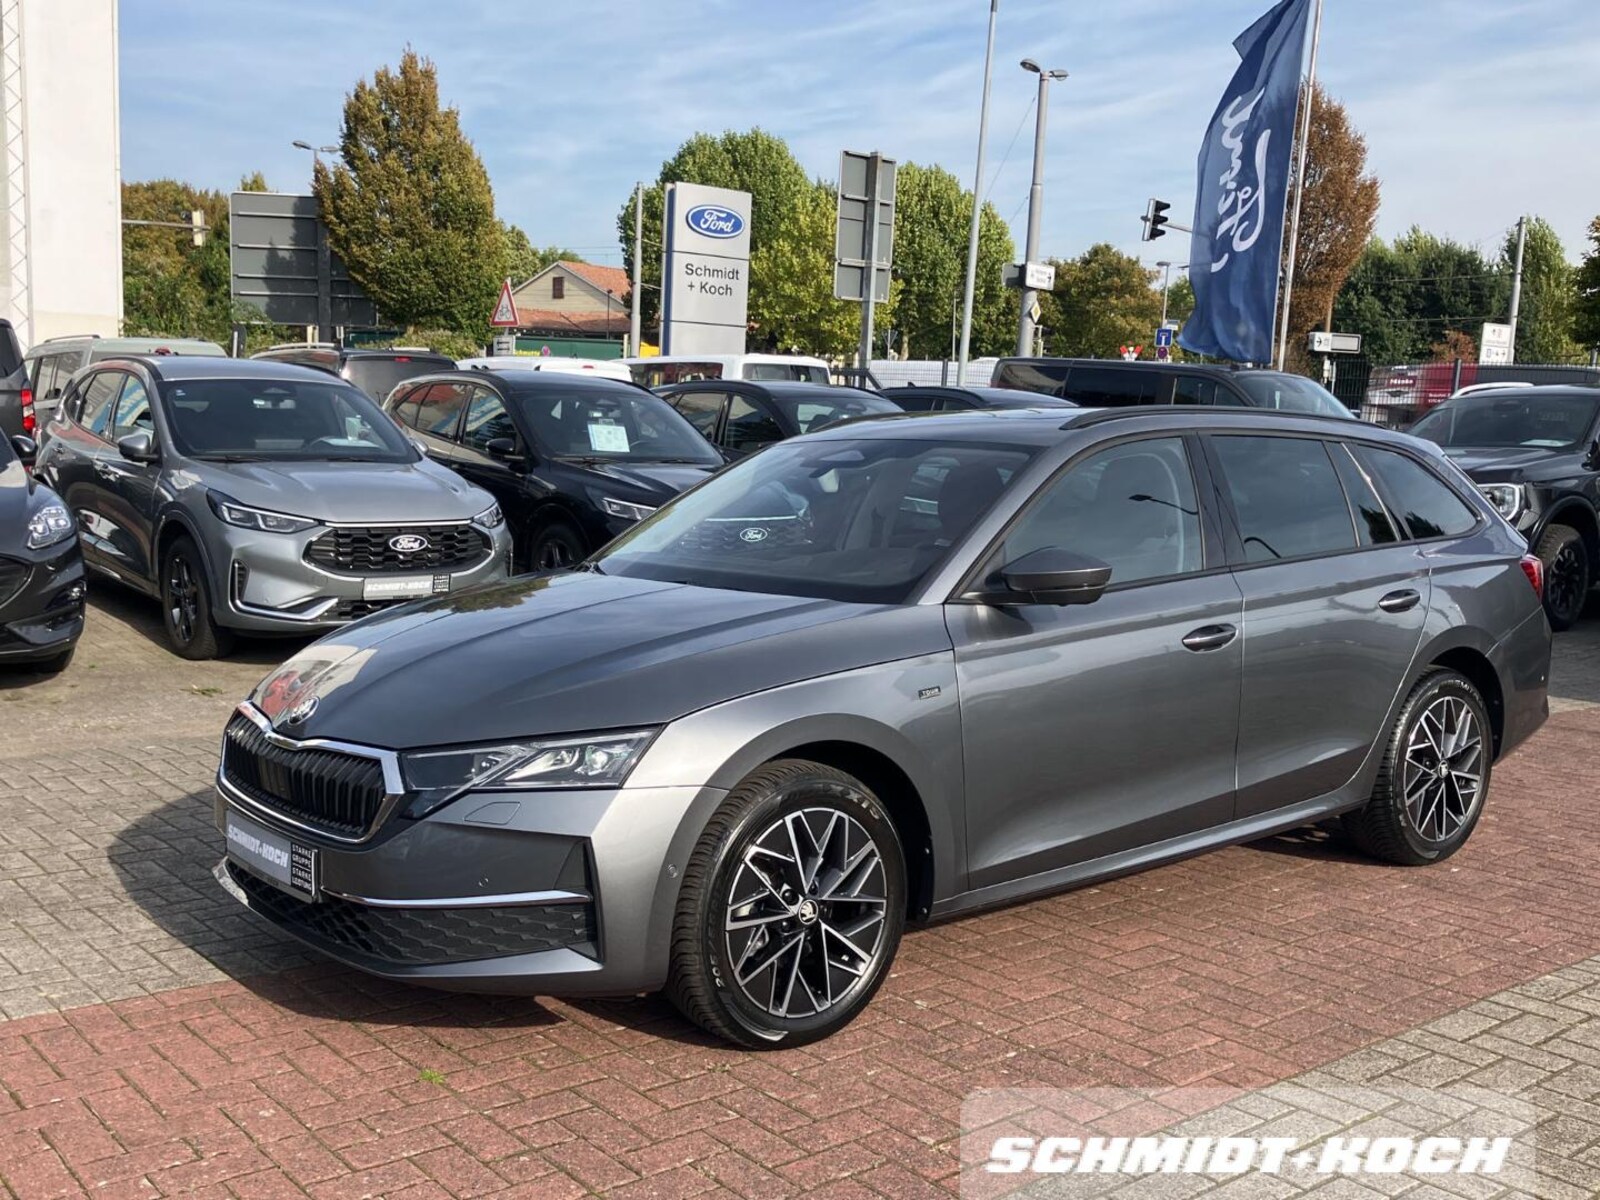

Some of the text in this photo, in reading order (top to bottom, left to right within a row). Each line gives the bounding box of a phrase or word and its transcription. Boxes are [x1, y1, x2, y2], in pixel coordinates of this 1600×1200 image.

[700, 210, 734, 232] Ford
[685, 262, 740, 281] Schmidt
[687, 281, 733, 297] + Koch
[397, 538, 420, 548] Ford
[745, 529, 763, 540] Ford
[228, 823, 289, 868] SCHMIDT+KOCH
